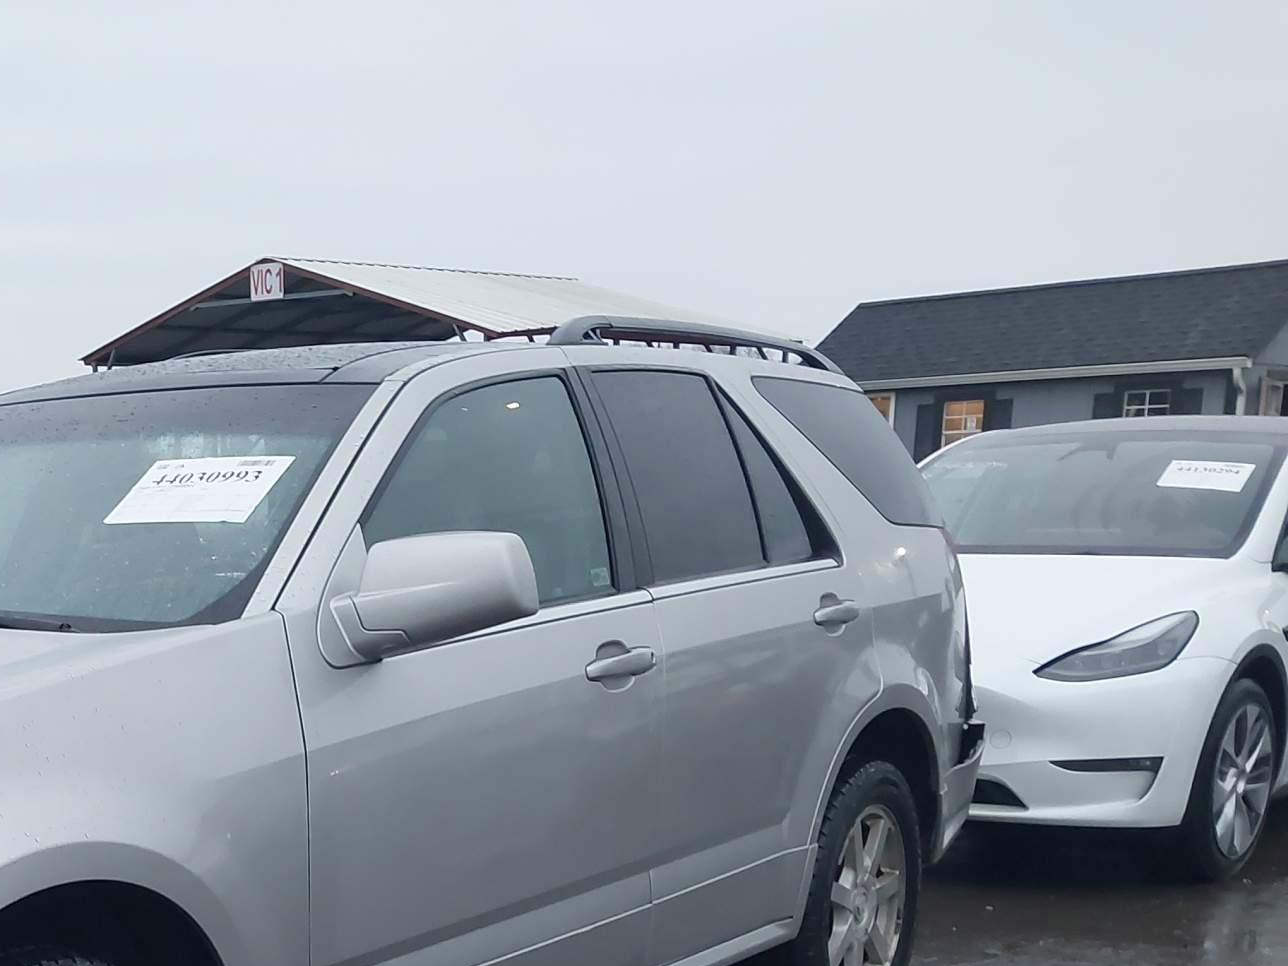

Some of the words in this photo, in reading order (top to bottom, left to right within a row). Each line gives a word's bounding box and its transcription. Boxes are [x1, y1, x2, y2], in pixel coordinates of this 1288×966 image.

[252, 268, 272, 296] VIC
[275, 267, 283, 293] 1
[152, 470, 264, 486] 44030993
